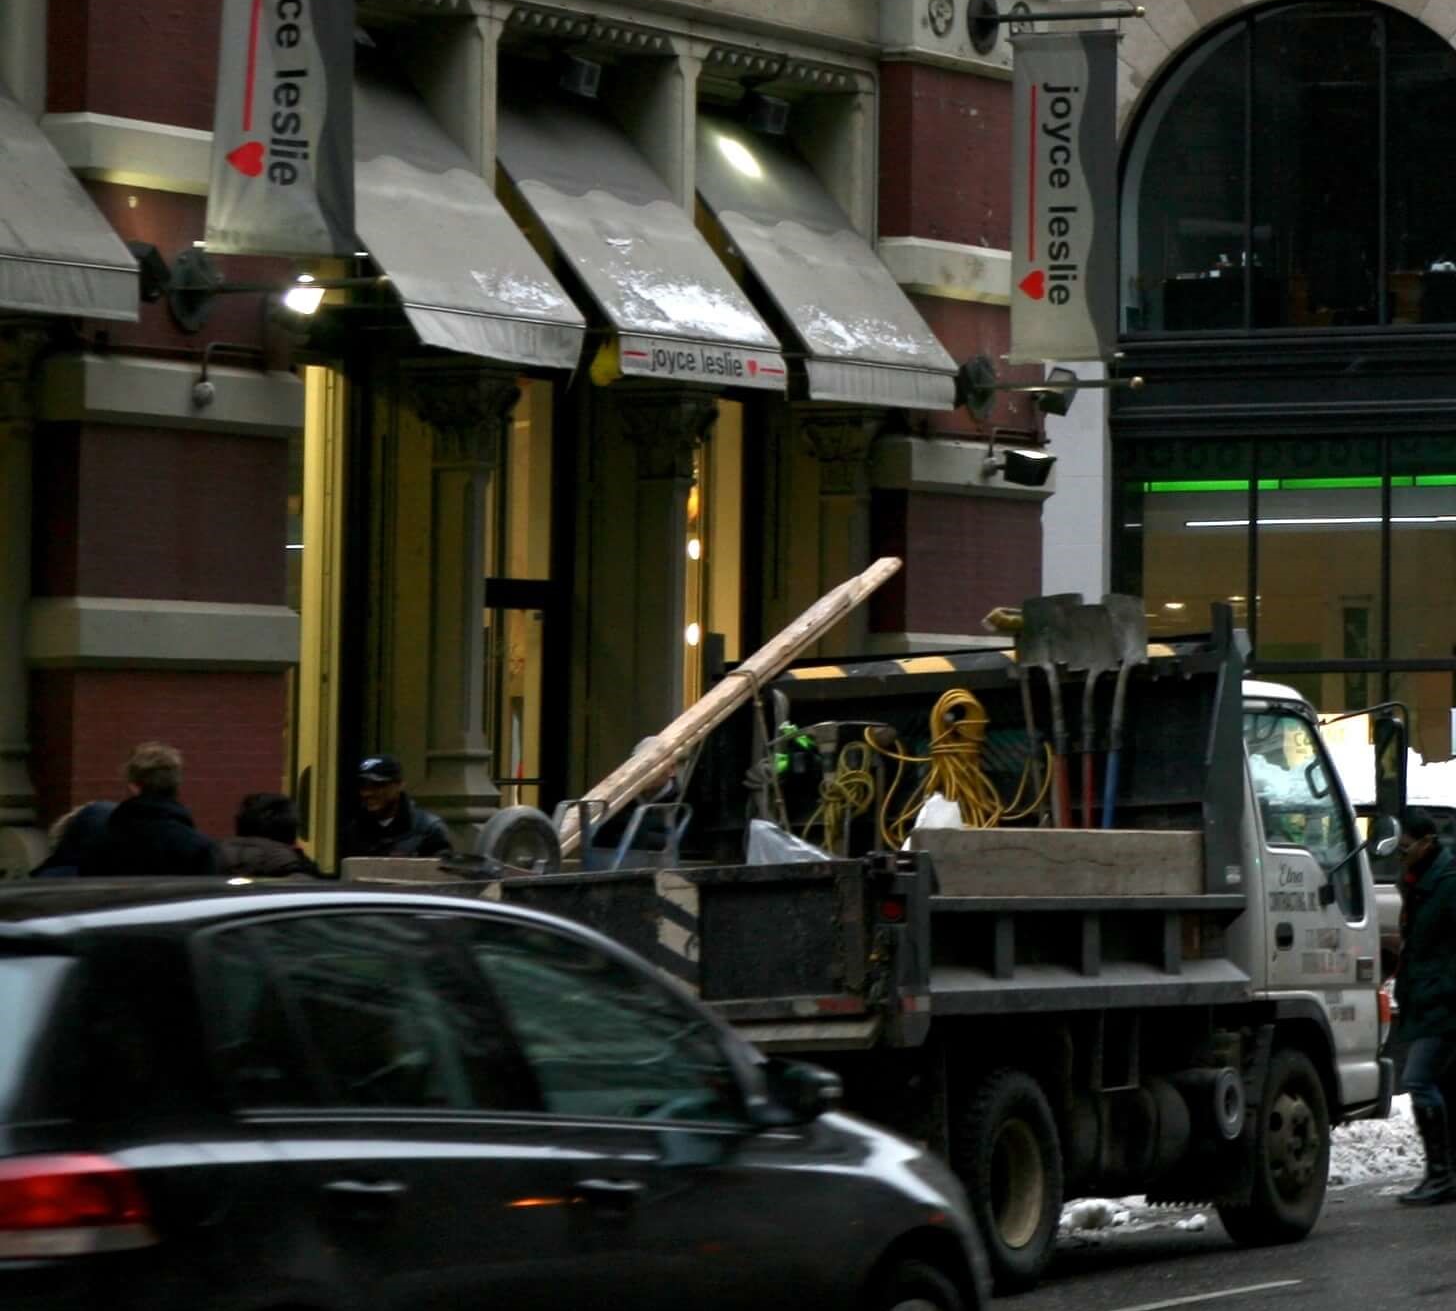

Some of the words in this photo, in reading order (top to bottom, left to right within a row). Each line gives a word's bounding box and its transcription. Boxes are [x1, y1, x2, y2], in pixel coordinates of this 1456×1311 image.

[267, 69, 309, 186] leslie
[1042, 83, 1079, 188] joyce
[1047, 206, 1077, 306] leslie
[651, 343, 696, 374] joyce
[701, 348, 742, 377] leslie
